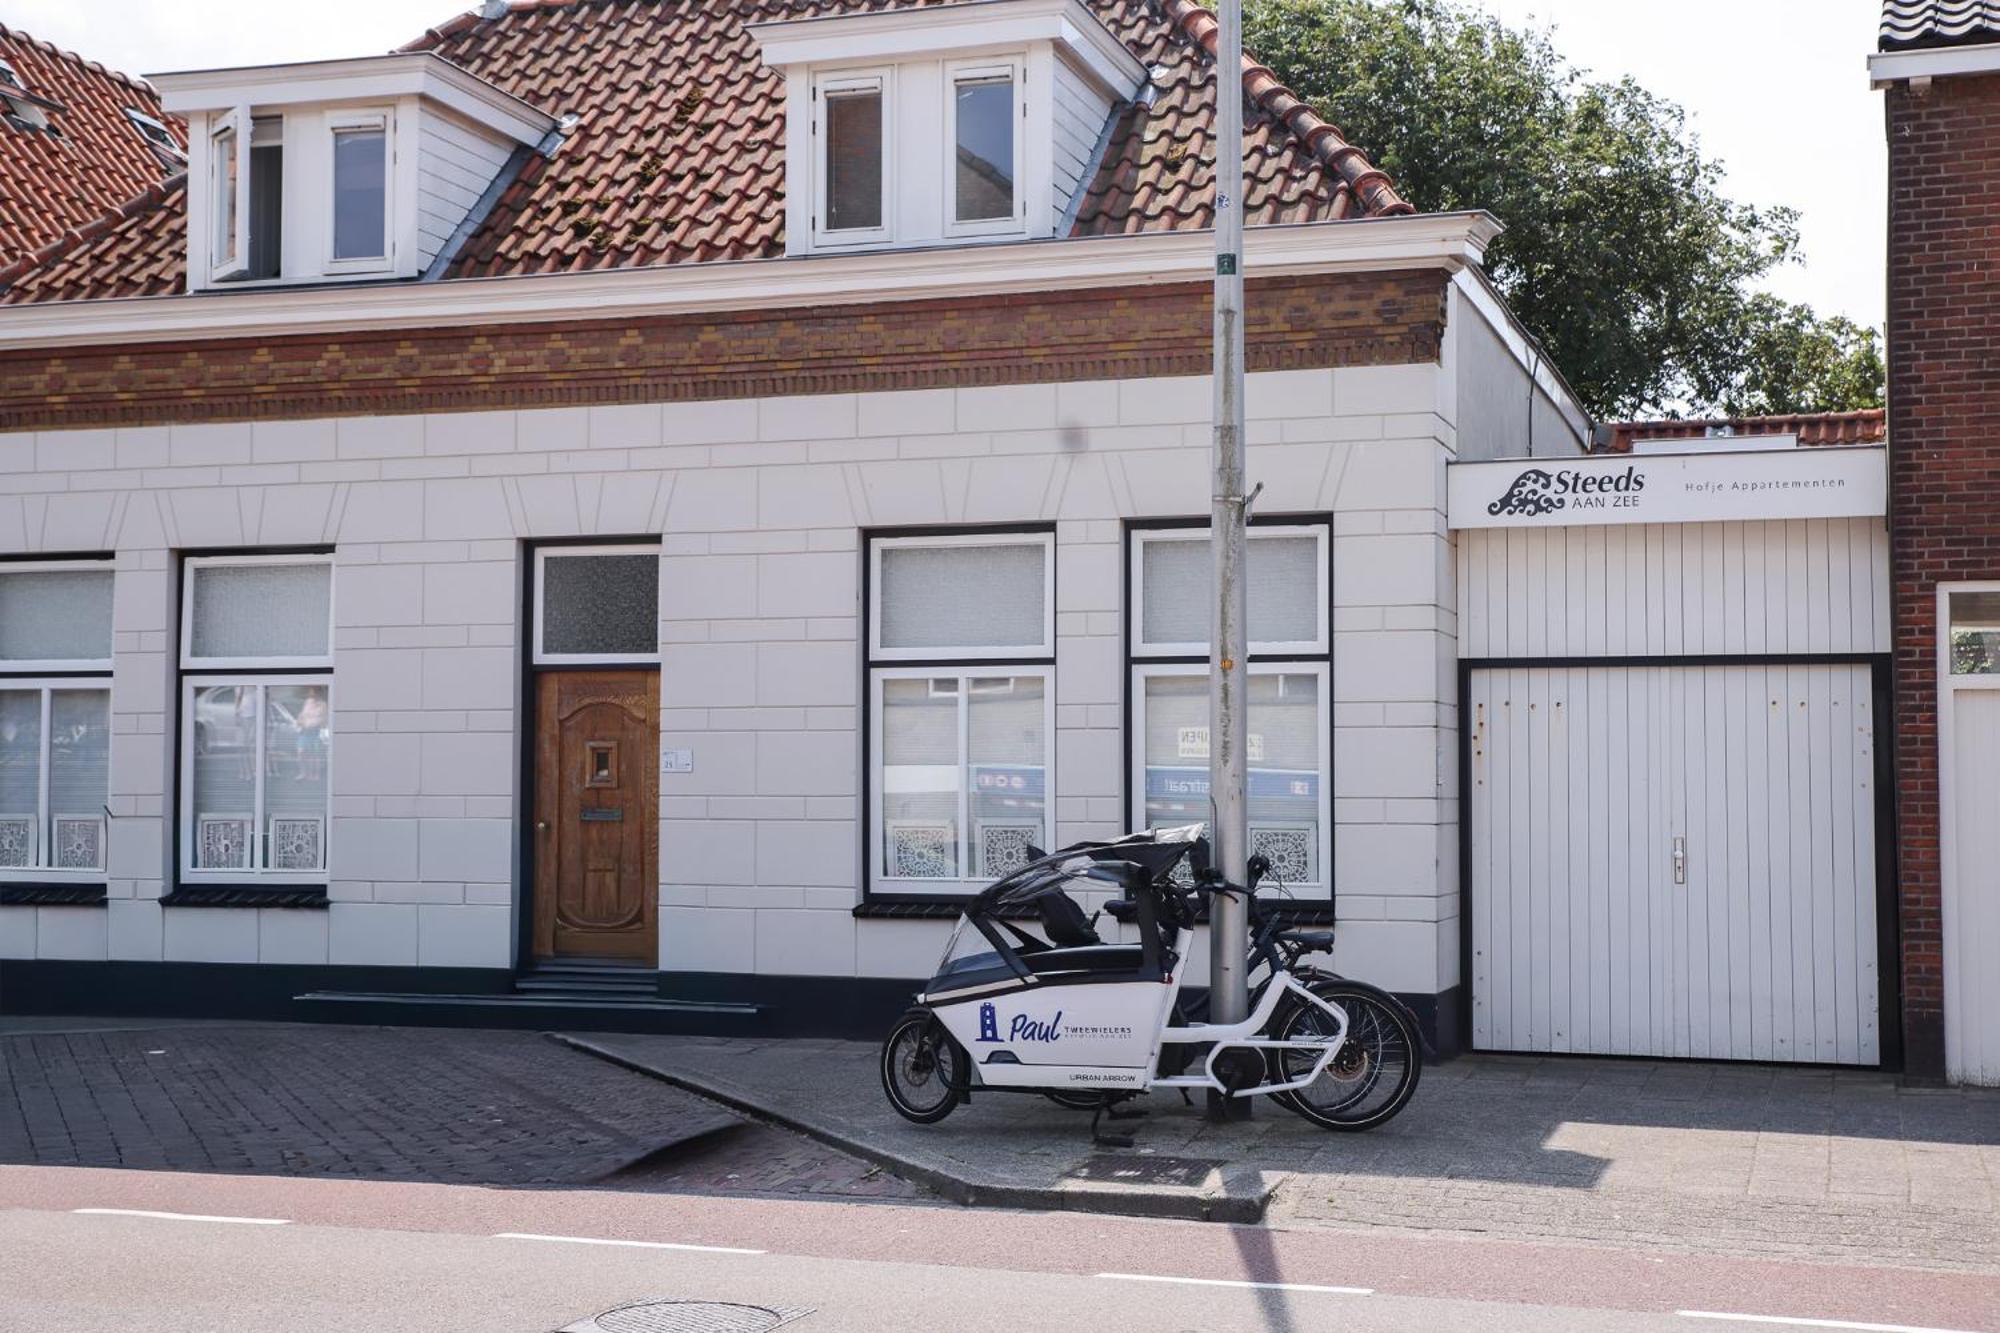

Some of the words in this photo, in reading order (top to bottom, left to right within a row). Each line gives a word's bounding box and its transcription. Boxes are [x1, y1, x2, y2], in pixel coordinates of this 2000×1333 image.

[1554, 466, 1645, 494] Steeds
[1685, 481, 1724, 493] Hofje
[1731, 478, 1846, 492] Appartementen
[1572, 497, 1605, 509] AAN
[1612, 495, 1640, 508] ZEE
[1010, 1011, 1062, 1042] Paul
[1064, 1026, 1132, 1034] TWEEWIELERS
[1069, 1073, 1101, 1082] URBAN
[1102, 1074, 1136, 1082] ARROW
